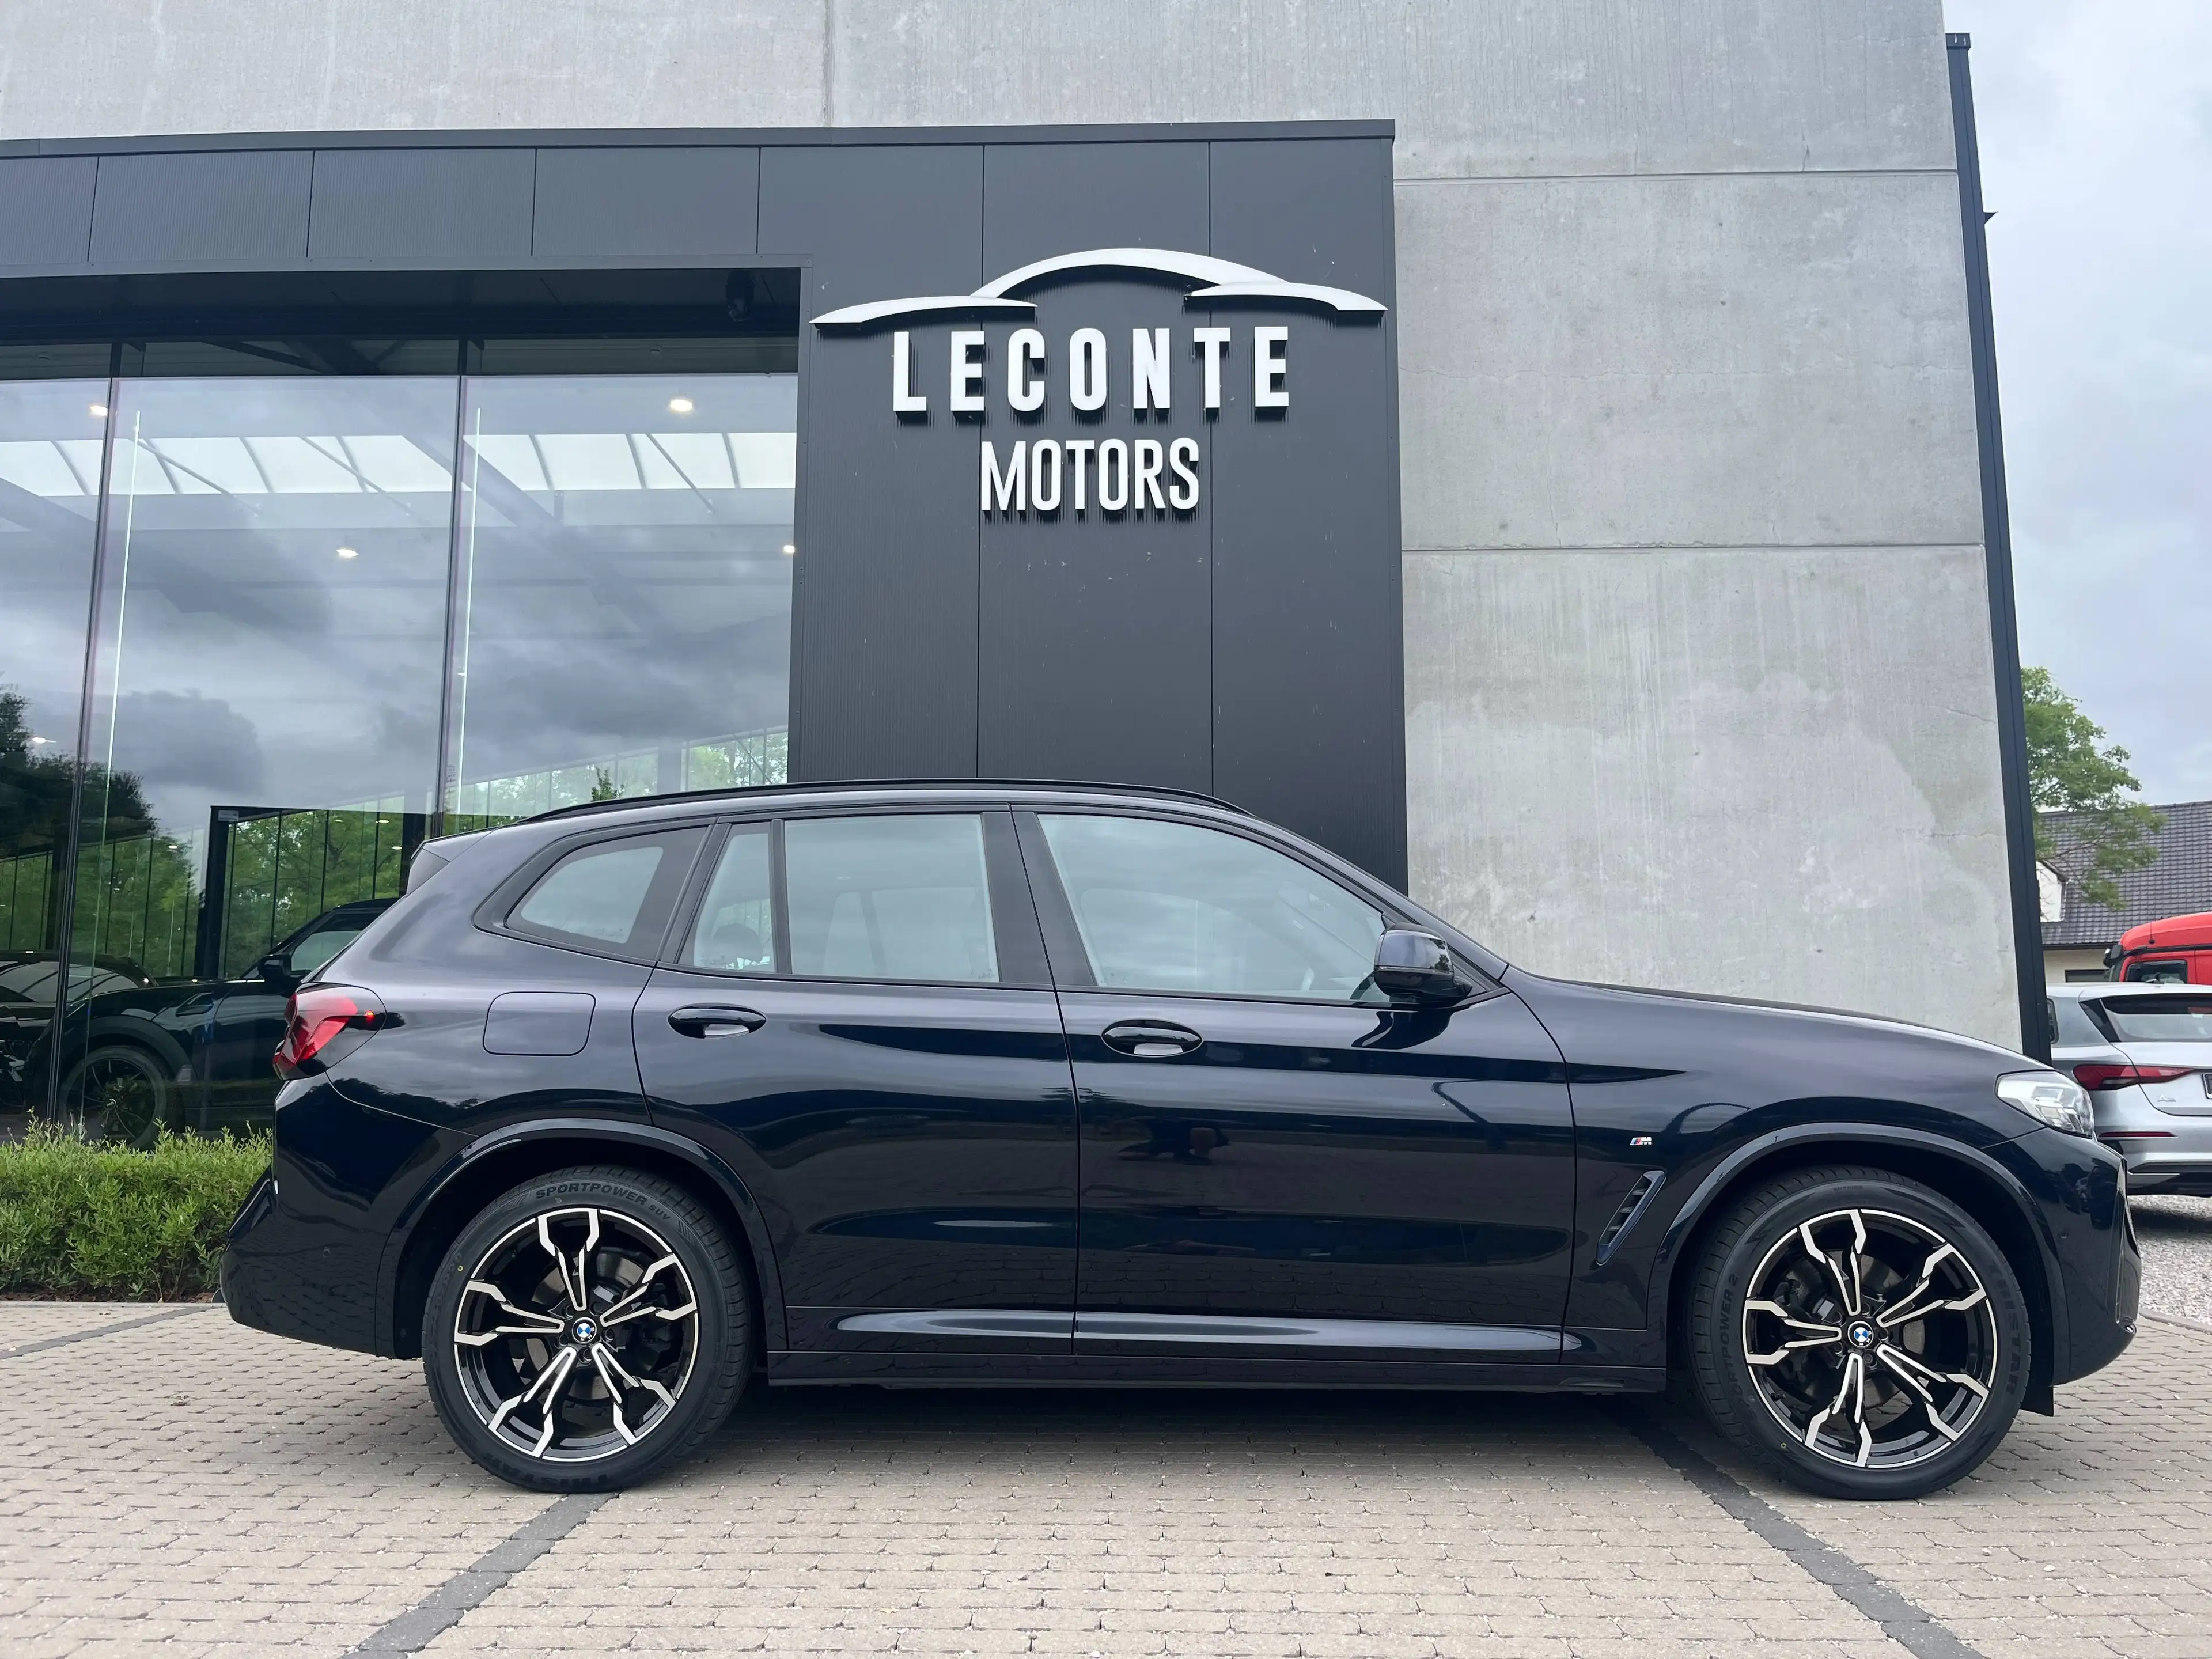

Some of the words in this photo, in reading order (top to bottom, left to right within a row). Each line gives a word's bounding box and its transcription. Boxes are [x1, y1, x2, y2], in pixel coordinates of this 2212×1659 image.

[892, 325, 1290, 412] LECONTE
[980, 438, 1199, 511] MOTORS
[536, 1182, 647, 1207] SPORTPOWER
[648, 1203, 671, 1221] SUV
[1728, 1272, 1739, 1287] 2
